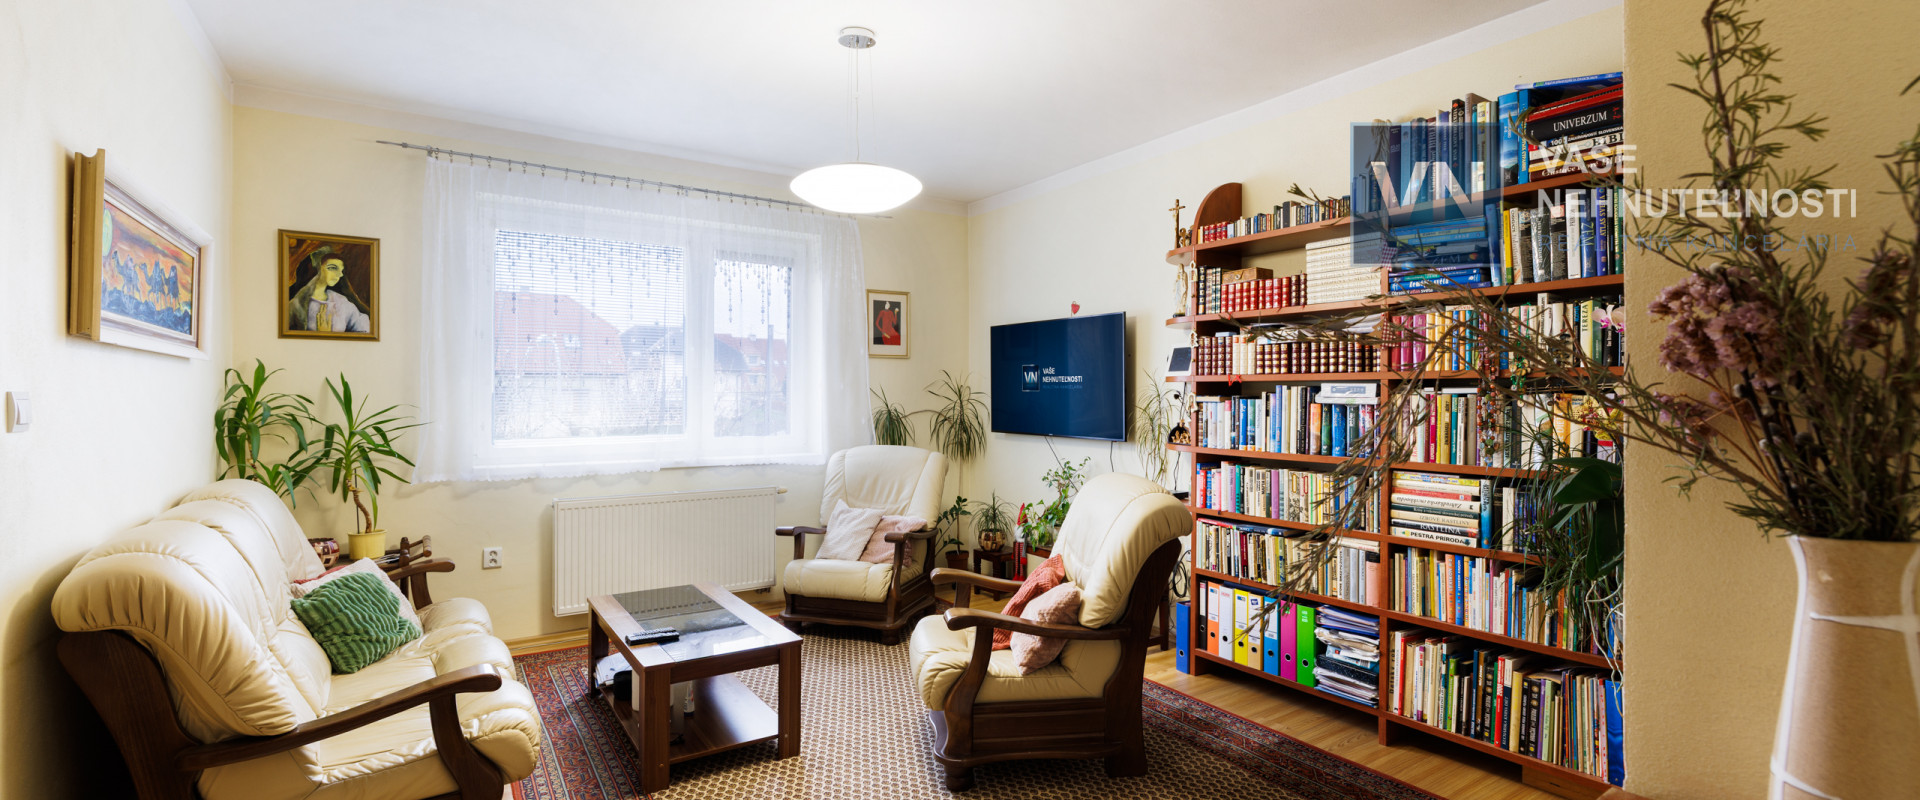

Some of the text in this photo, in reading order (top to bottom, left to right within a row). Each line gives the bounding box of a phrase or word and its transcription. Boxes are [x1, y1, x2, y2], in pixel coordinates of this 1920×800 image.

[1553, 110, 1607, 132] UNIVERZUM
[1042, 366, 1056, 375] VAŠE
[1024, 371, 1038, 384] VN
[1420, 523, 1461, 535] RASTLINA
